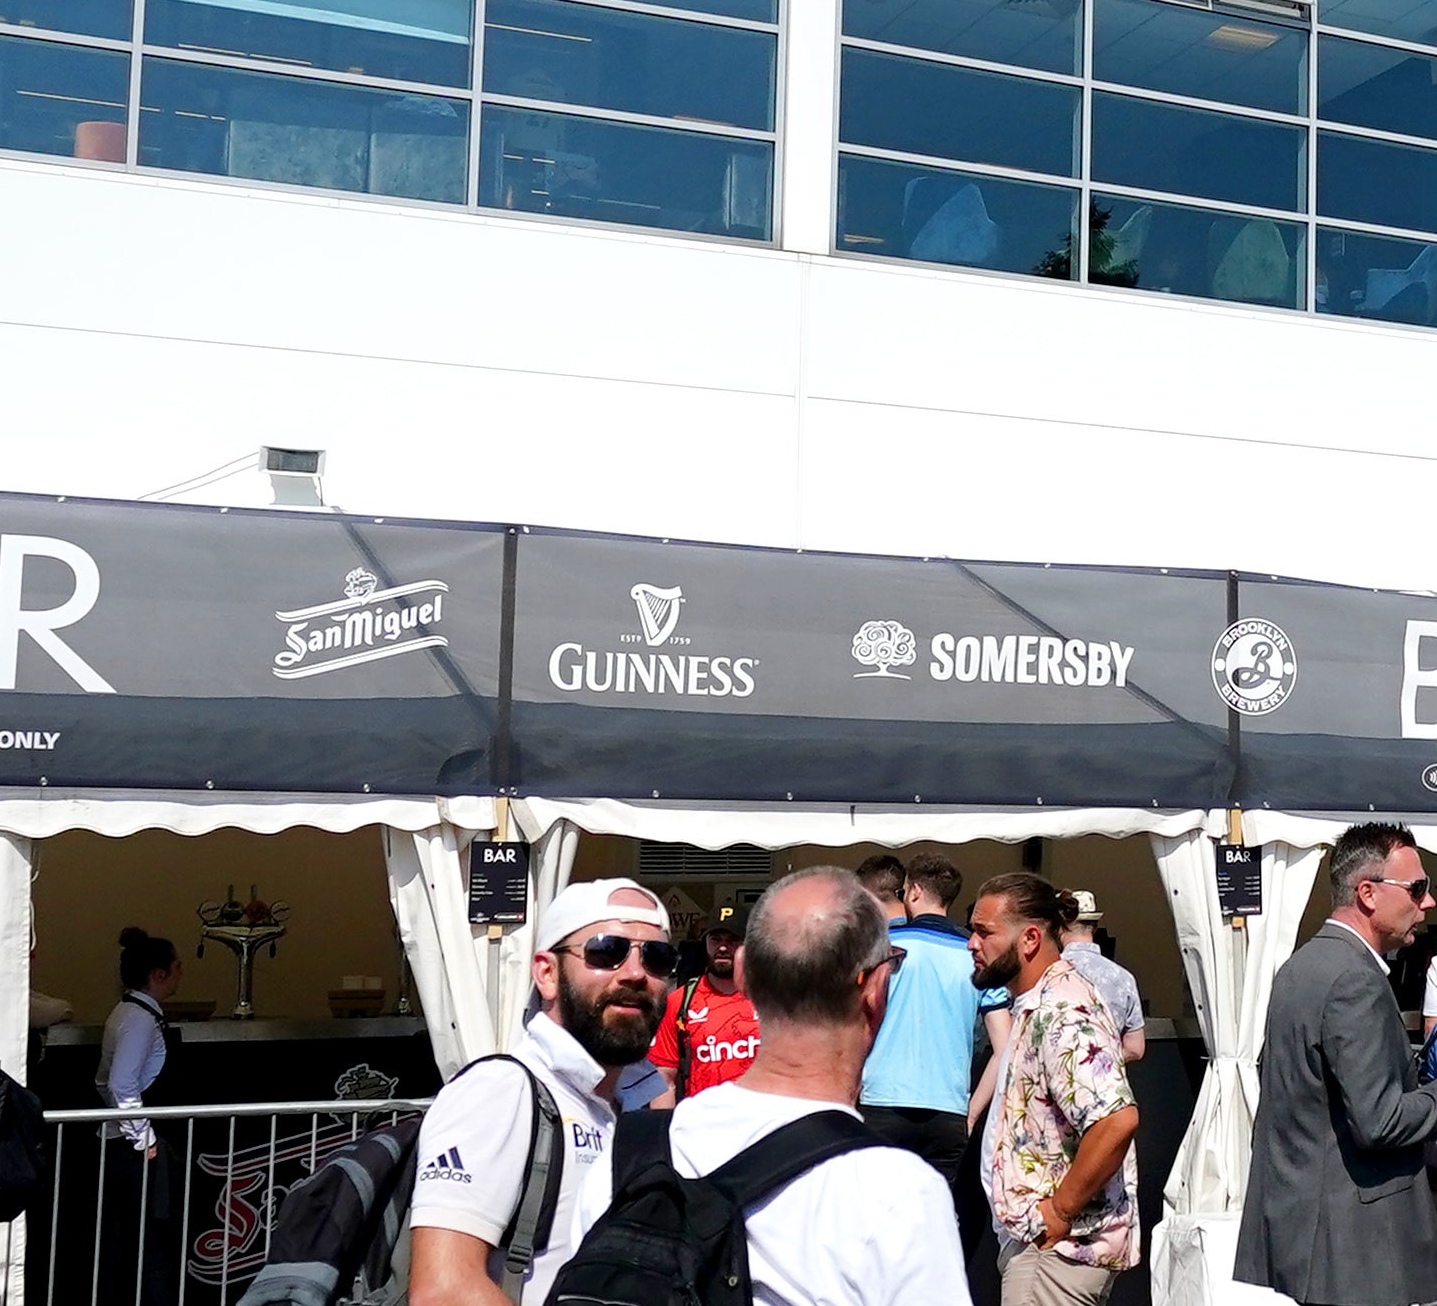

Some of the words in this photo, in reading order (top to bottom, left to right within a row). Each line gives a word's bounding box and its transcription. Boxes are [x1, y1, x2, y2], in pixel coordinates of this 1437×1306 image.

[669, 636, 691, 645] 1759
[1221, 622, 1288, 651] BROOKLYN
[548, 642, 756, 698] GUINNESS
[929, 632, 1135, 688] SOMERSBY
[1221, 682, 1286, 711] BREWERY
[483, 848, 517, 863] BAR
[1225, 850, 1252, 863] BAR
[419, 1169, 473, 1185] adidas
